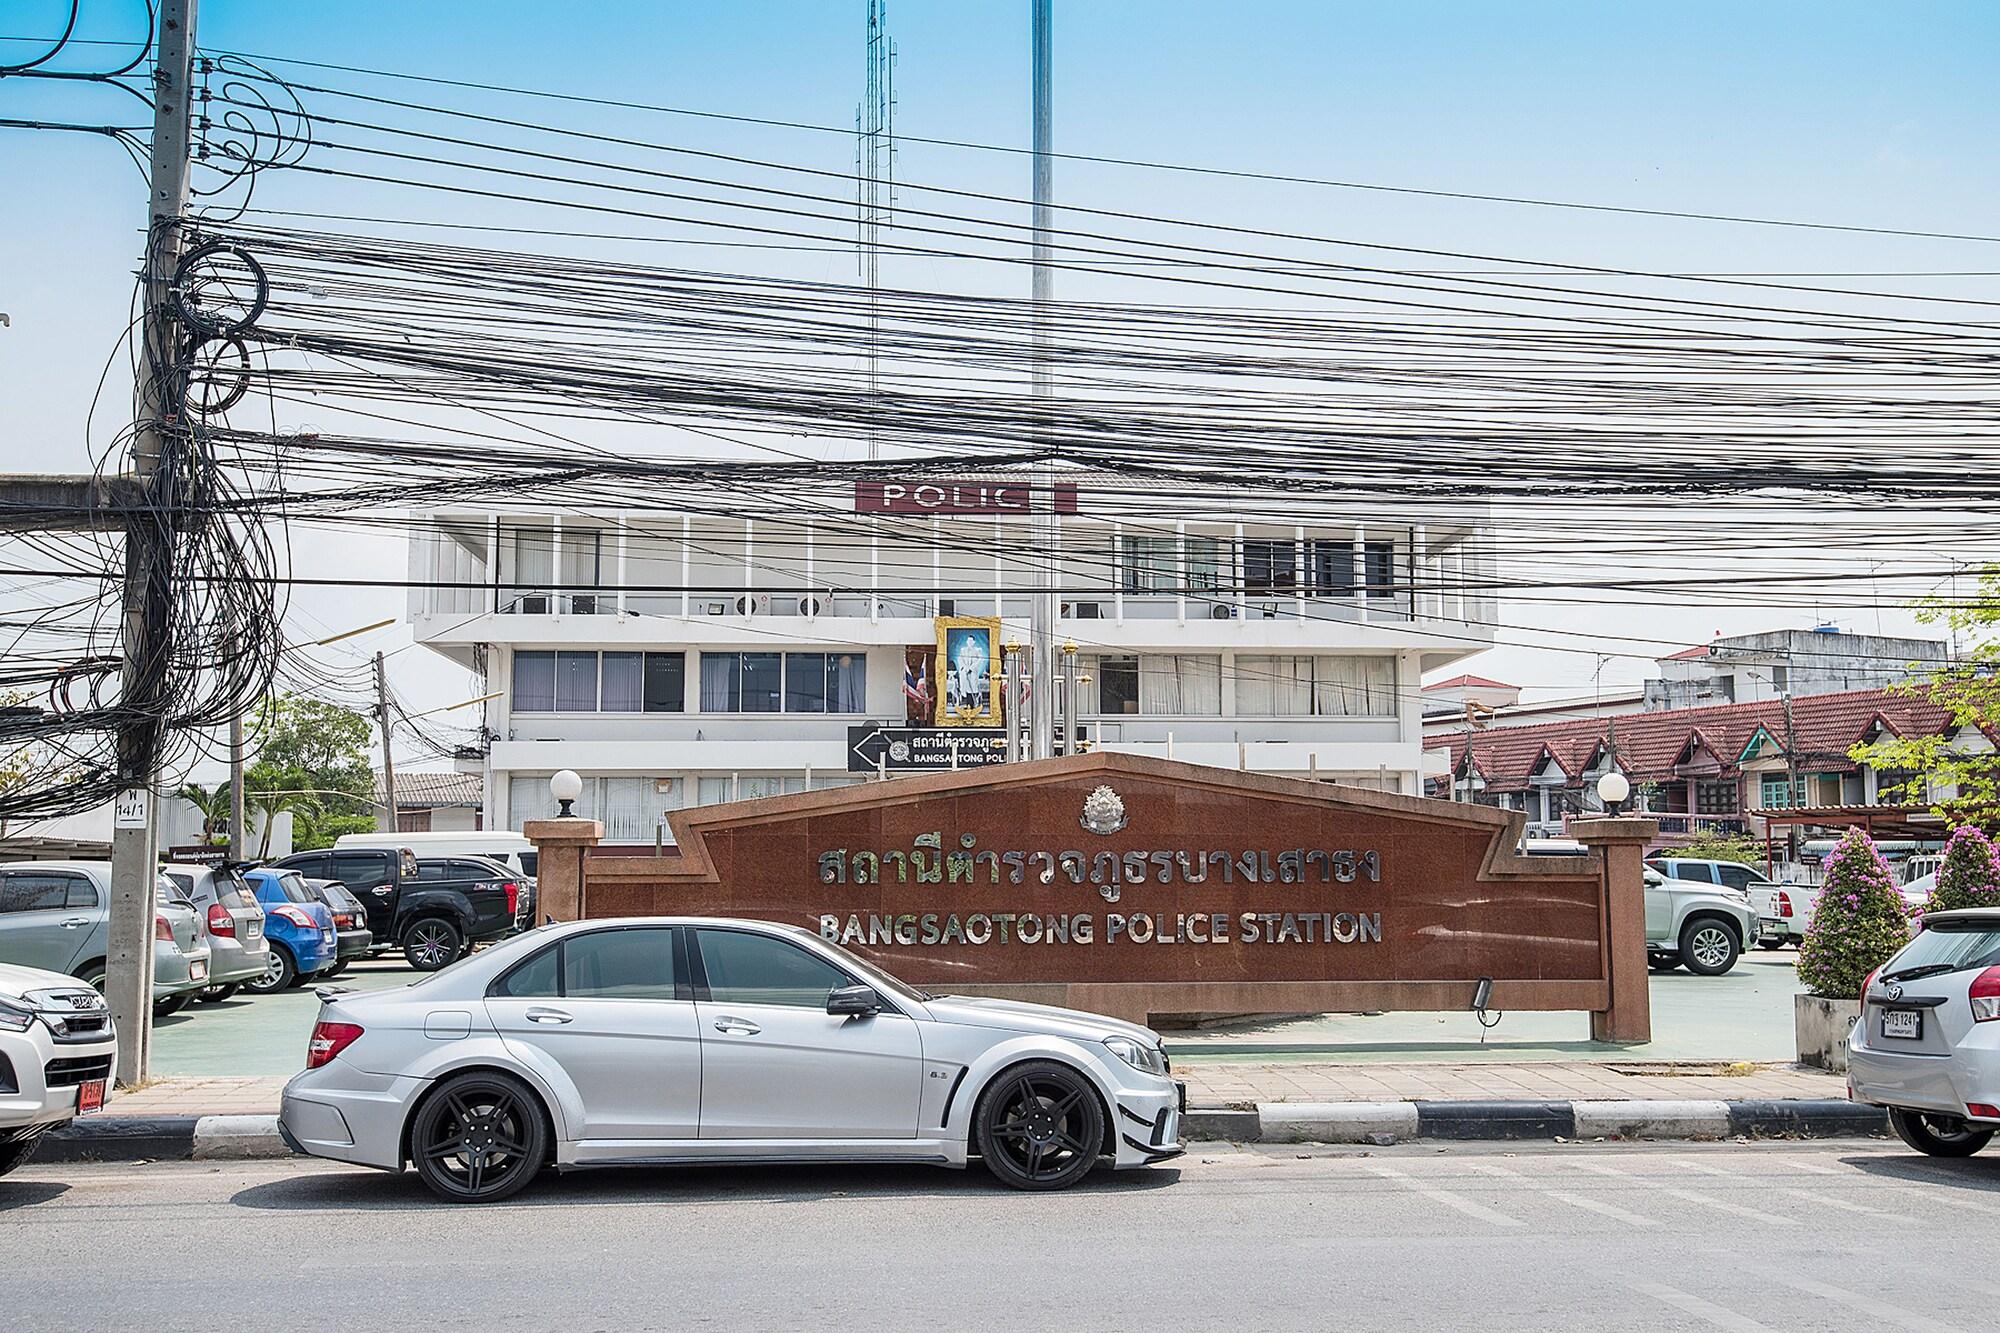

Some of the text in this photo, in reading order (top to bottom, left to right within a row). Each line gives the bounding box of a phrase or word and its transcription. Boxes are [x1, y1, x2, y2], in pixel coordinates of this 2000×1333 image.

[883, 484, 1022, 508] POLIC
[913, 753, 984, 763] BANGSATONG
[117, 803, 144, 817] 14/1
[818, 831, 1382, 903] สถานีตำรวจภูธรบางเสาธง
[819, 911, 1383, 945] BANGSAOTONG POLICE STATION
